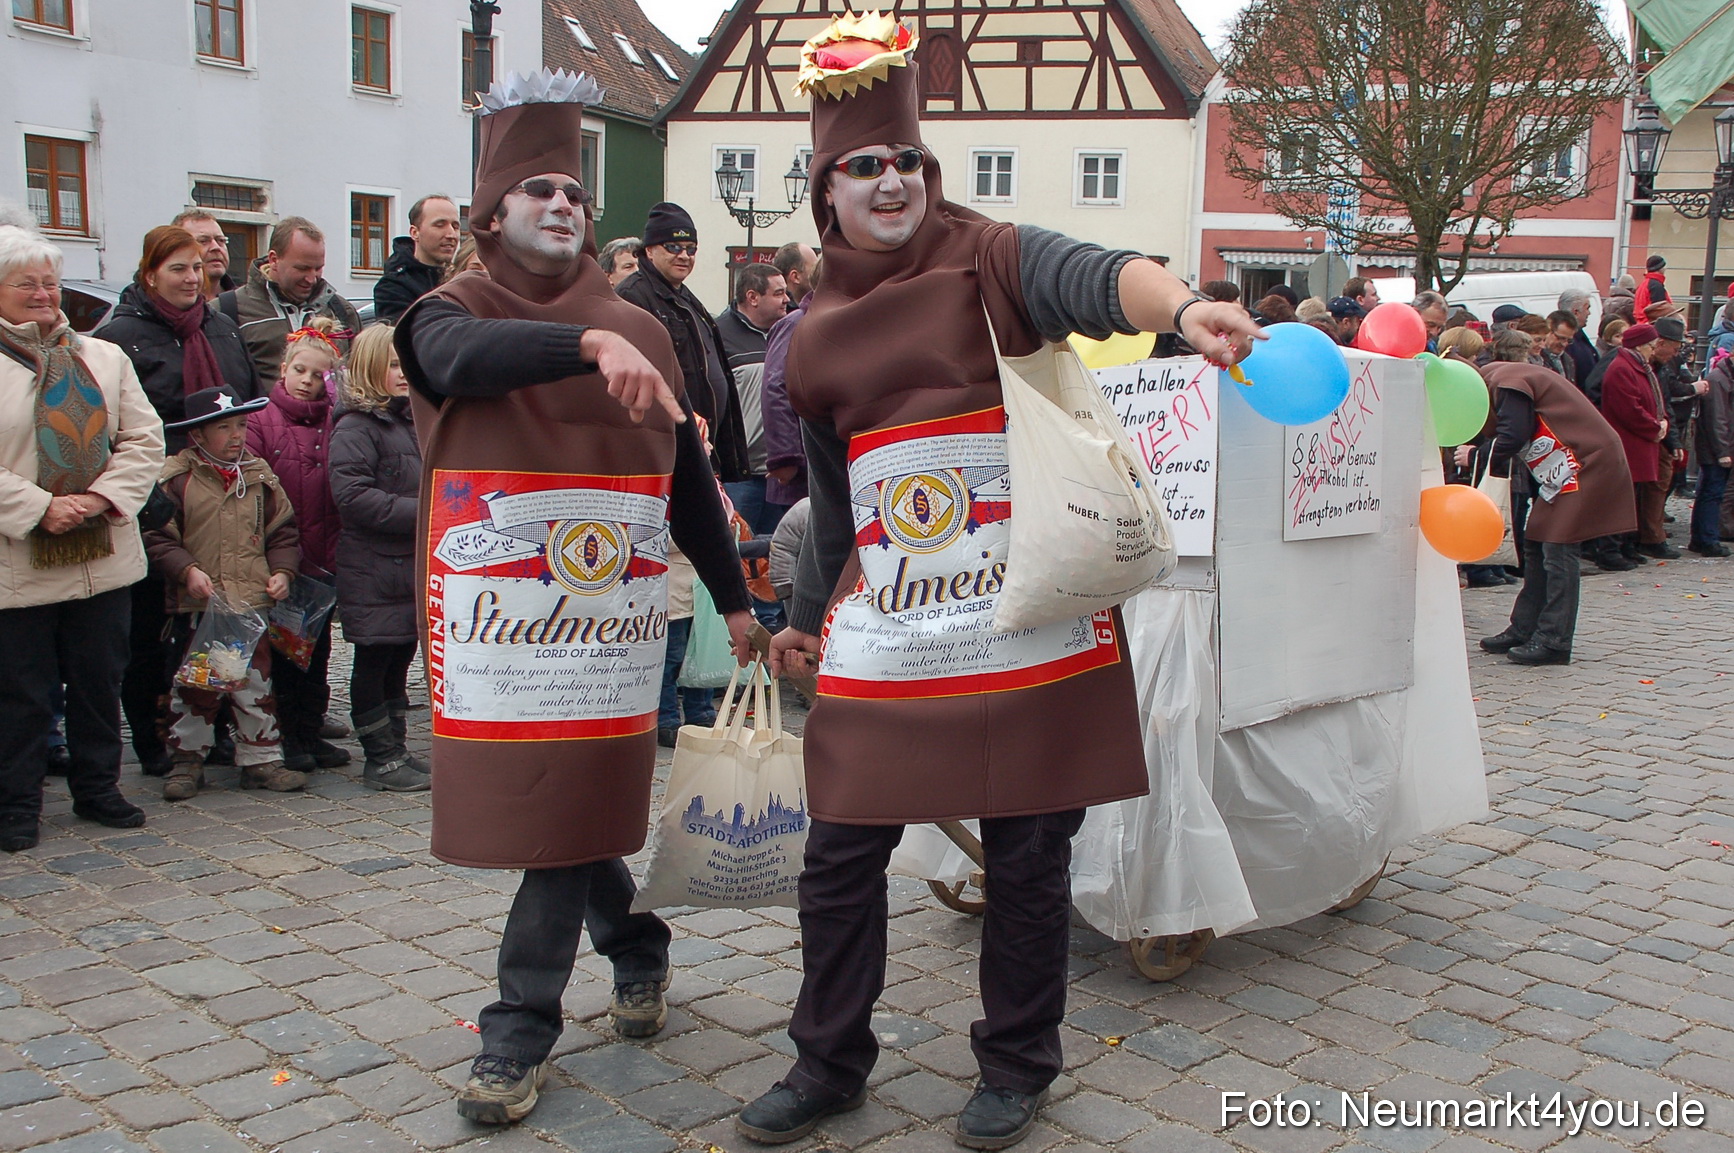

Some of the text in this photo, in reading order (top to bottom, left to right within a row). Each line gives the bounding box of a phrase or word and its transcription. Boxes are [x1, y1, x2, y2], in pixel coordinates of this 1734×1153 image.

[1289, 359, 1380, 528] ZENSIERT
[1151, 451, 1210, 475] Genuss
[1347, 444, 1377, 466] Genuss
[1067, 502, 1100, 521] HUBER
[1346, 491, 1380, 514] verboten
[1116, 540, 1145, 551] Service
[1116, 545, 1156, 562] Worldwid
[451, 591, 668, 645] Studmeister
[927, 608, 944, 620] OF
[947, 600, 993, 617] LAGERS
[840, 620, 867, 633] Drink
[866, 624, 891, 636] when
[888, 631, 908, 641] you
[910, 630, 936, 639] can,
[942, 618, 982, 635] Drink
[428, 574, 444, 718] GENUINE
[535, 648, 630, 659] LORD OF LAGERS
[871, 644, 900, 656] your
[903, 638, 956, 654] drinking
[901, 649, 995, 668] under the table
[456, 663, 490, 676] Drink
[493, 664, 525, 676] when
[523, 668, 550, 680] you
[554, 668, 578, 676] can,
[583, 662, 617, 676] Drink
[620, 661, 640, 673] when
[507, 682, 541, 696] your
[544, 679, 593, 694] drinking
[539, 693, 622, 707] under the table
[687, 820, 805, 849] STADT-APOTHEKE
[711, 849, 746, 864] Michael
[747, 852, 767, 863] Popp
[775, 843, 784, 852] K.
[706, 855, 787, 874] Maria-Hilf-Straße 3
[689, 877, 724, 892] Telefon:
[749, 881, 764, 891] 62)
[765, 881, 776, 889] 94
[713, 868, 779, 885] 92334 Berching
[687, 887, 722, 900] Telefax:
